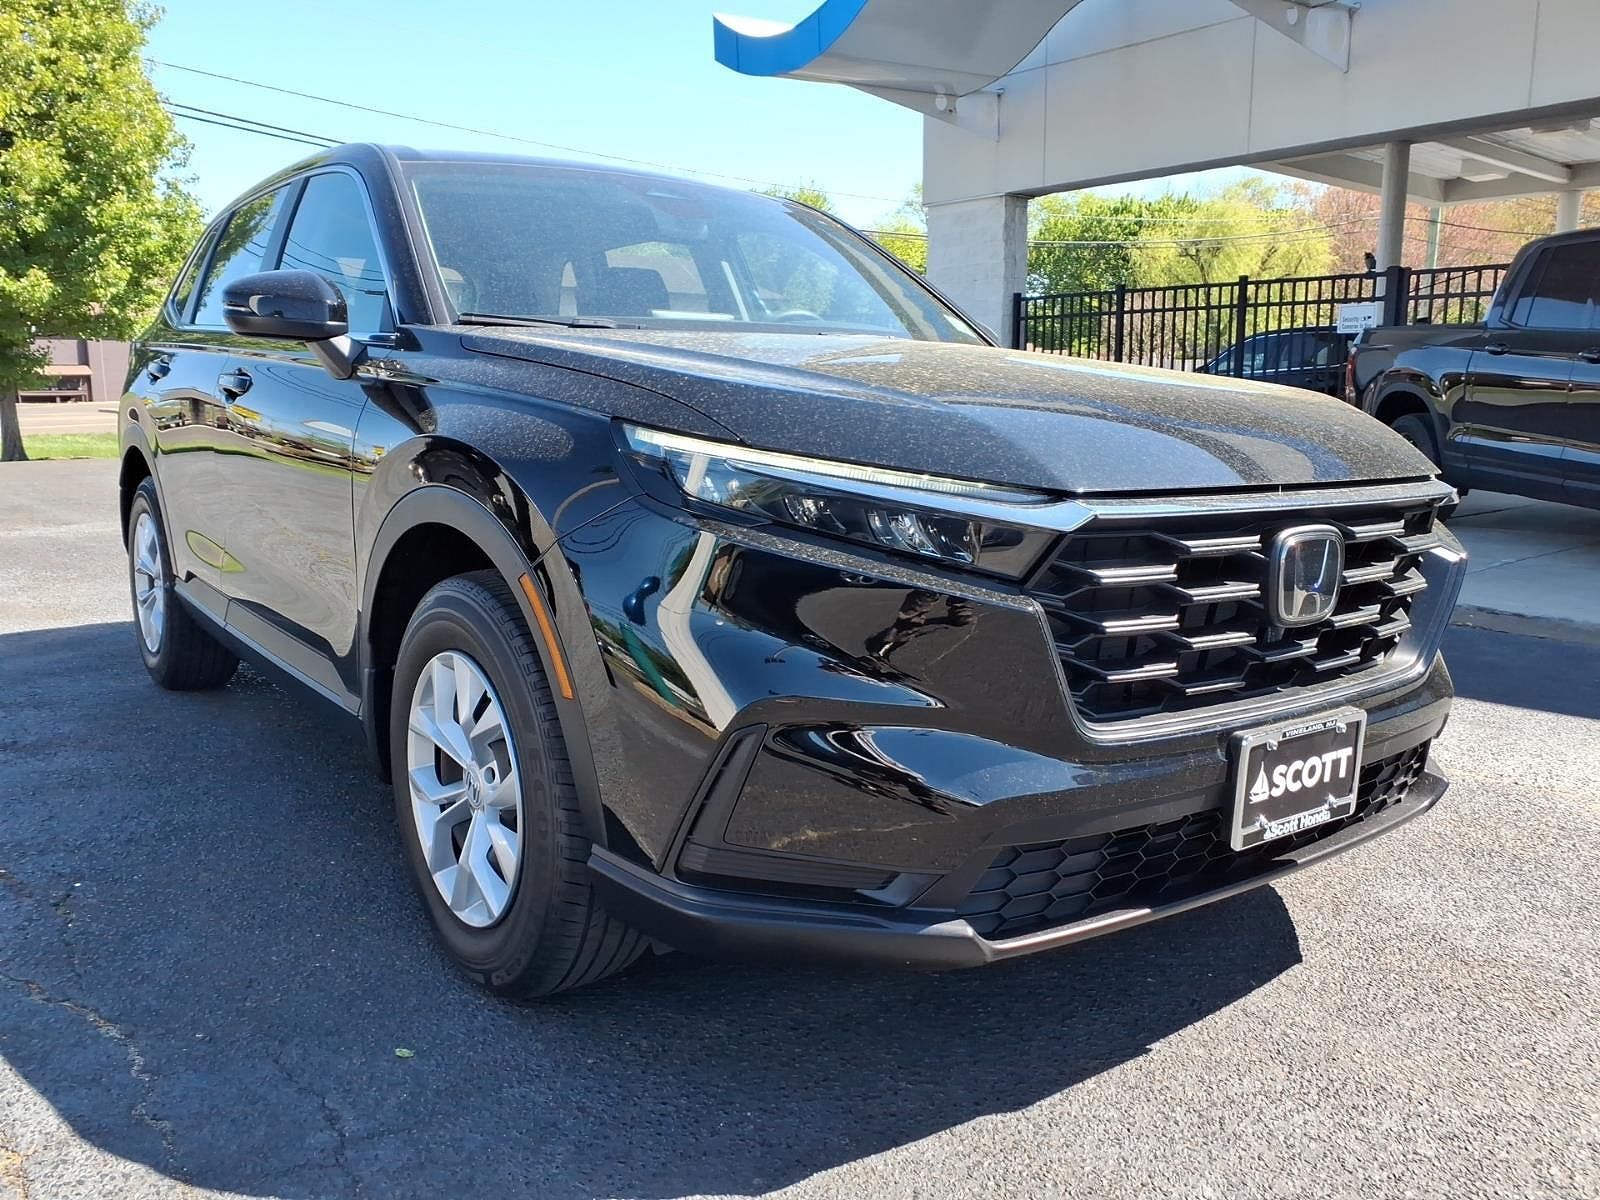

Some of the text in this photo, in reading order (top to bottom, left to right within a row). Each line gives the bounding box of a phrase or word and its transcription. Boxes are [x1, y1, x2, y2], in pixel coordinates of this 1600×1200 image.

[1270, 747, 1353, 797] SCOTT
[1271, 809, 1331, 837] Scott Honda
